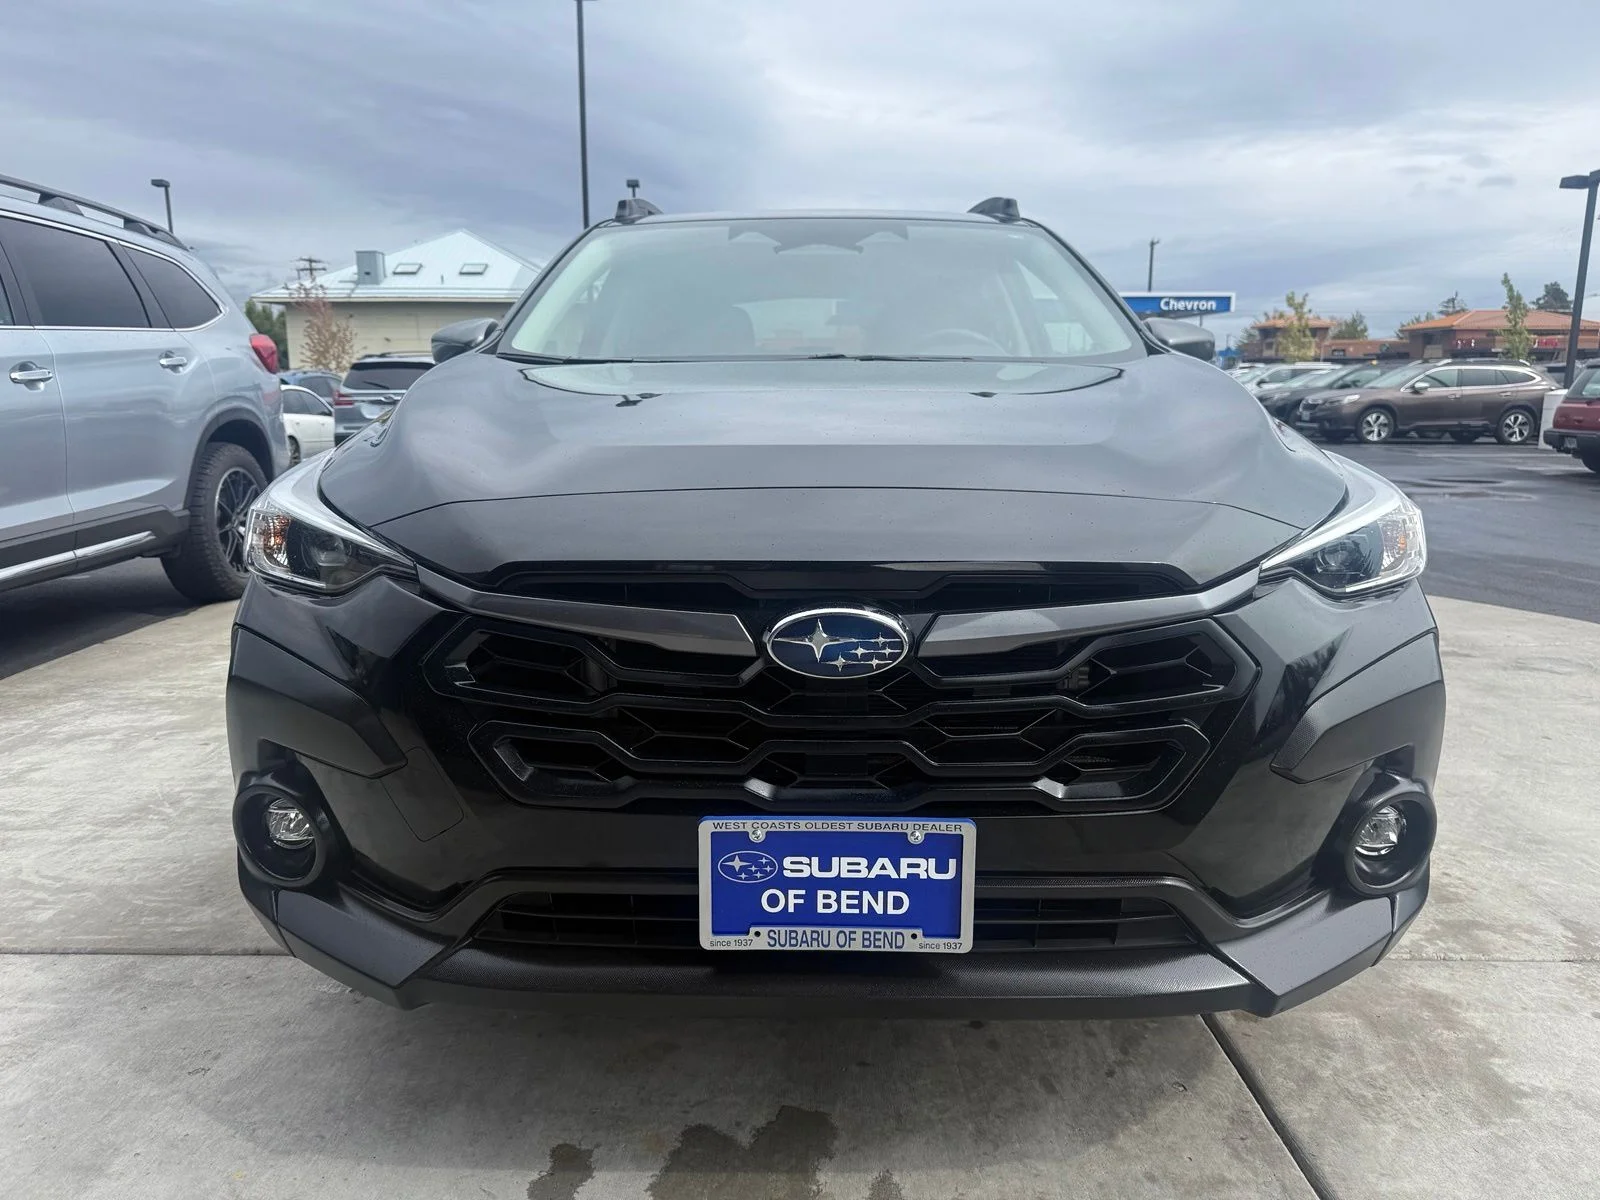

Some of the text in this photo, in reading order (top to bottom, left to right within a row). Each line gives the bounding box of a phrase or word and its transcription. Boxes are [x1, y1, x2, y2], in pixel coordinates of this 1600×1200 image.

[1160, 297, 1217, 311] Chevron
[712, 821, 963, 832] WEST COASTS OLDEST SUBARU DEALER
[782, 856, 957, 880] SUBARU
[760, 888, 910, 915] OF BEND
[709, 938, 754, 947] since 1937
[767, 929, 905, 949] SUBARU OF BEND
[918, 941, 963, 950] since 1937
